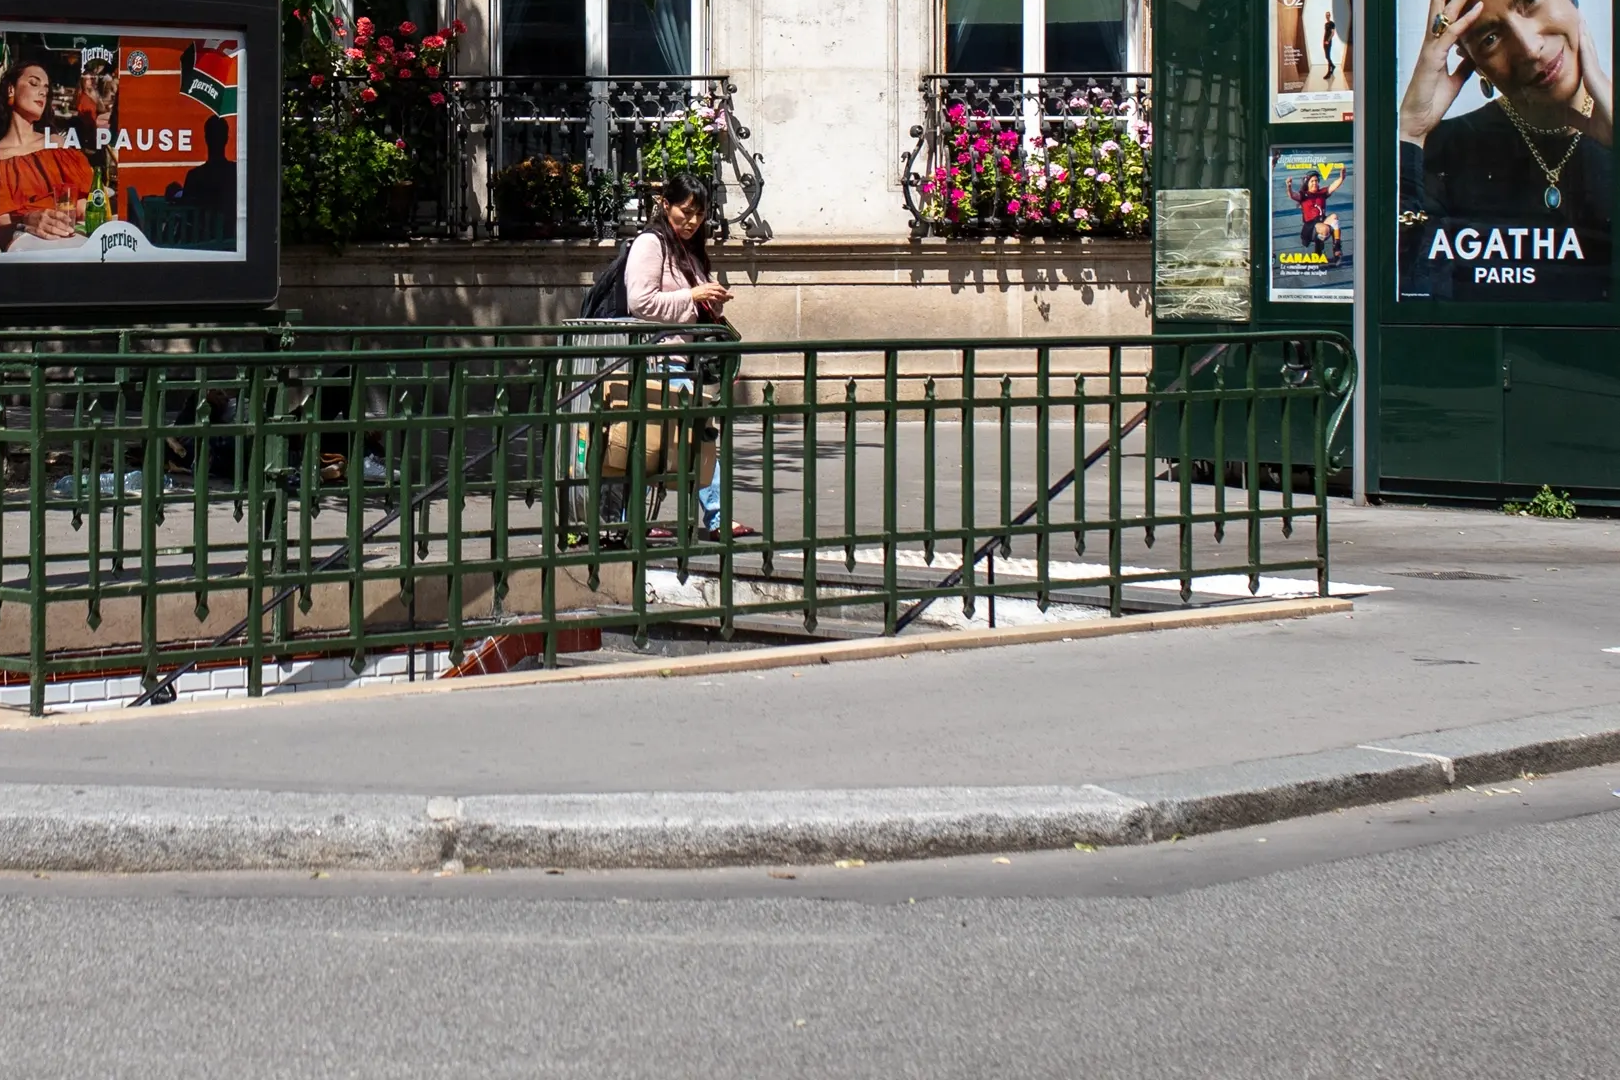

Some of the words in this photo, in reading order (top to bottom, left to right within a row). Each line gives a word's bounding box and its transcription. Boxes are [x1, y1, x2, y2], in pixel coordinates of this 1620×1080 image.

[44, 126, 81, 149] LA
[96, 128, 192, 152] PAUSE
[1277, 153, 1327, 166] diplomatique
[1428, 227, 1585, 260] AGATHA
[1279, 252, 1329, 263] CANADA
[1474, 267, 1536, 284] PARIS
